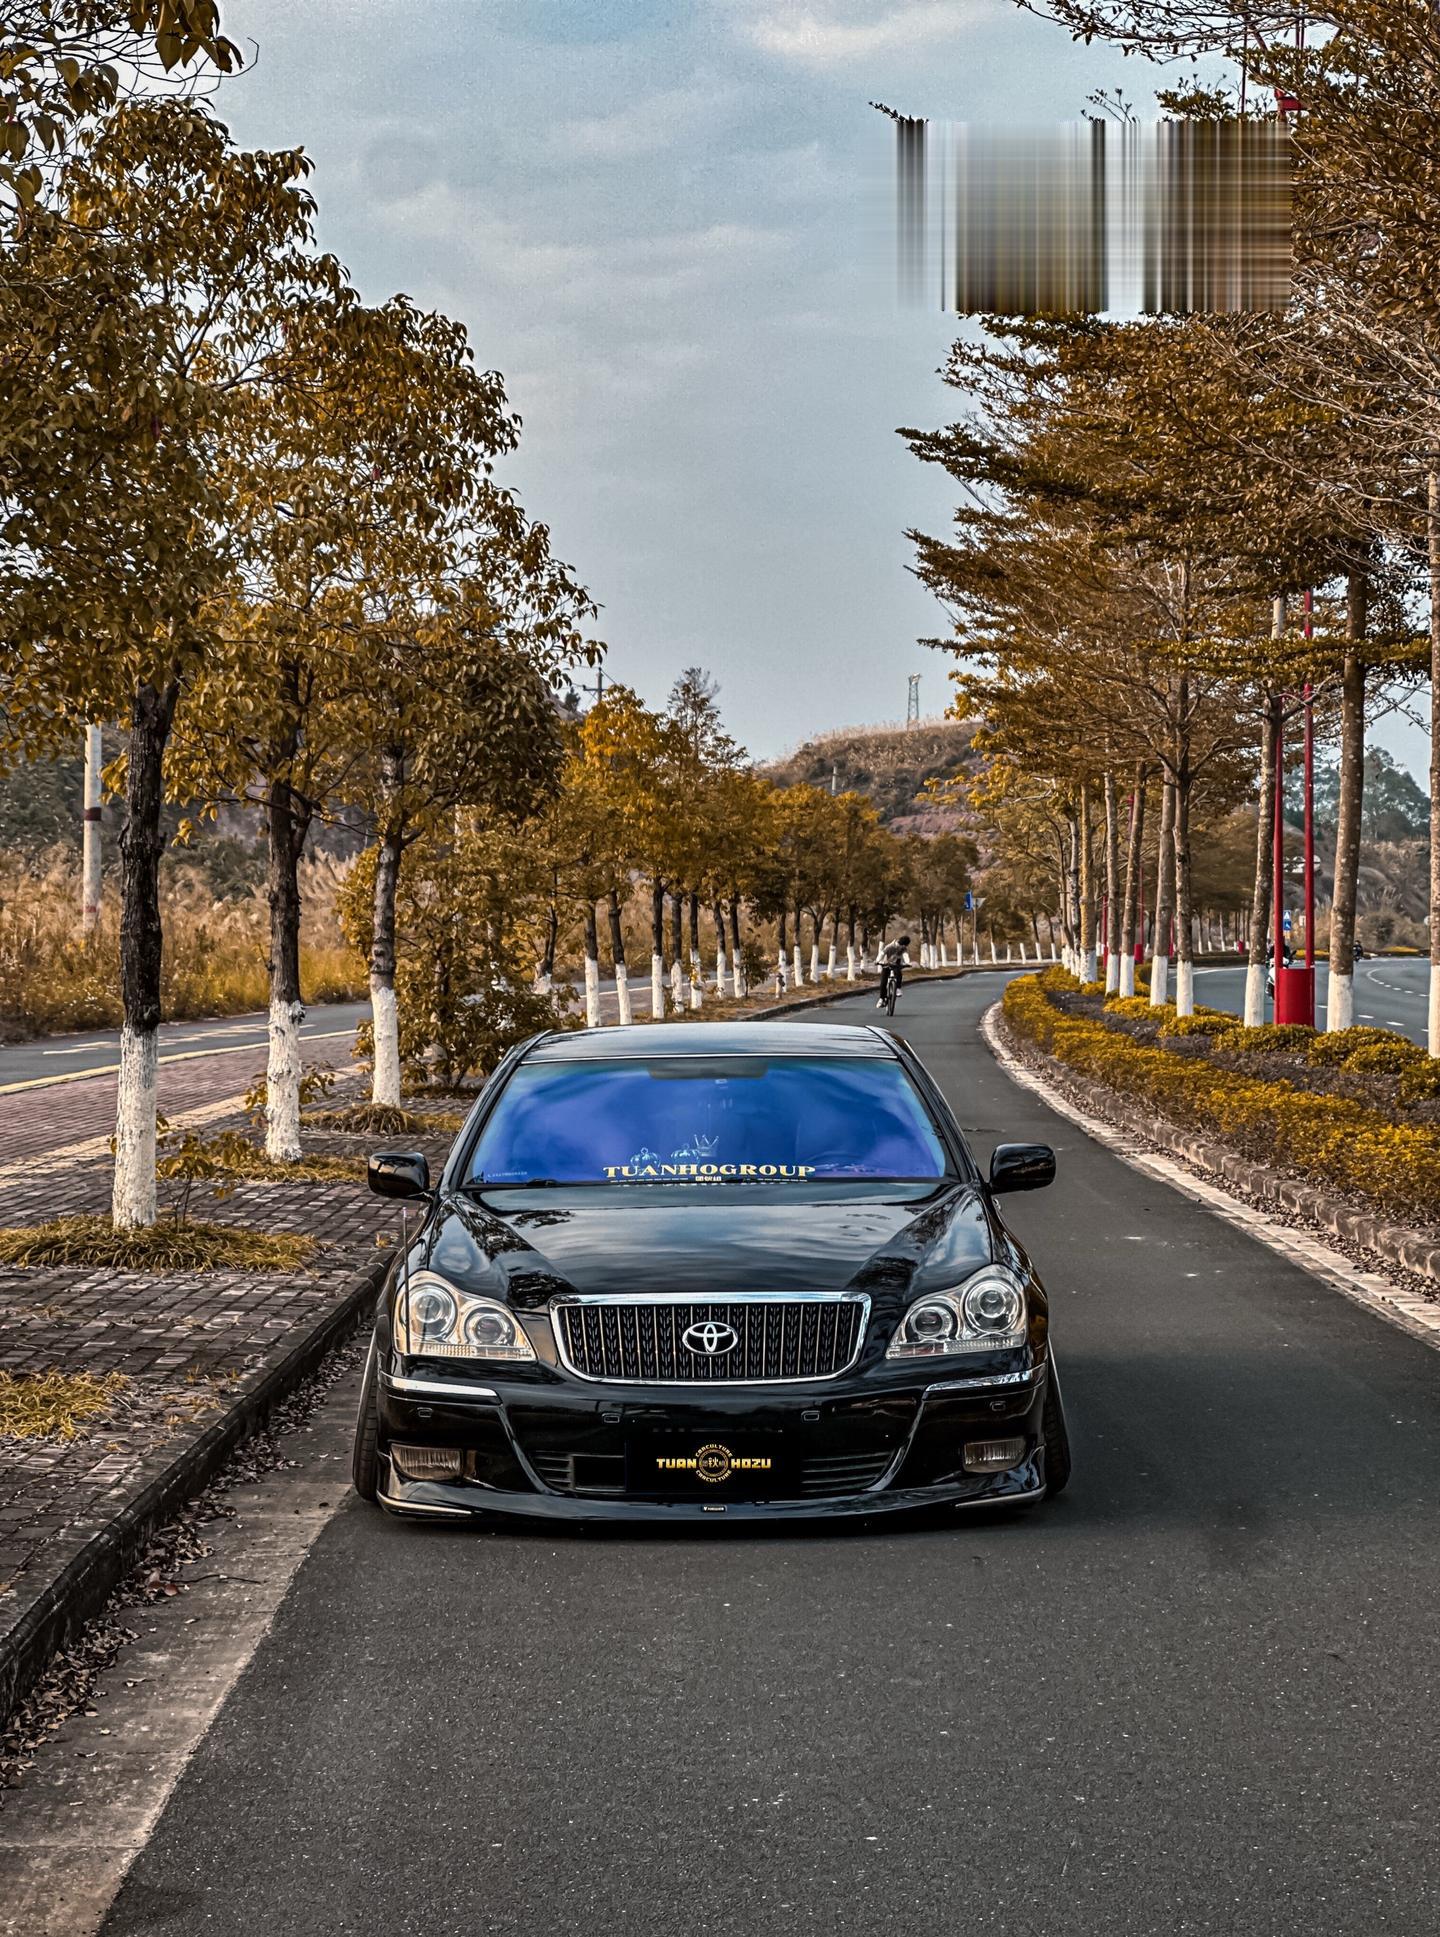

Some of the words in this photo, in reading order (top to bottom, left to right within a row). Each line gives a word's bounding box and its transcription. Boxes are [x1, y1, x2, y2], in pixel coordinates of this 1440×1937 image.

[603, 1164, 816, 1178] TUANHOGROUP
[656, 1458, 697, 1469] TUAN
[730, 1458, 772, 1469] HOZU
